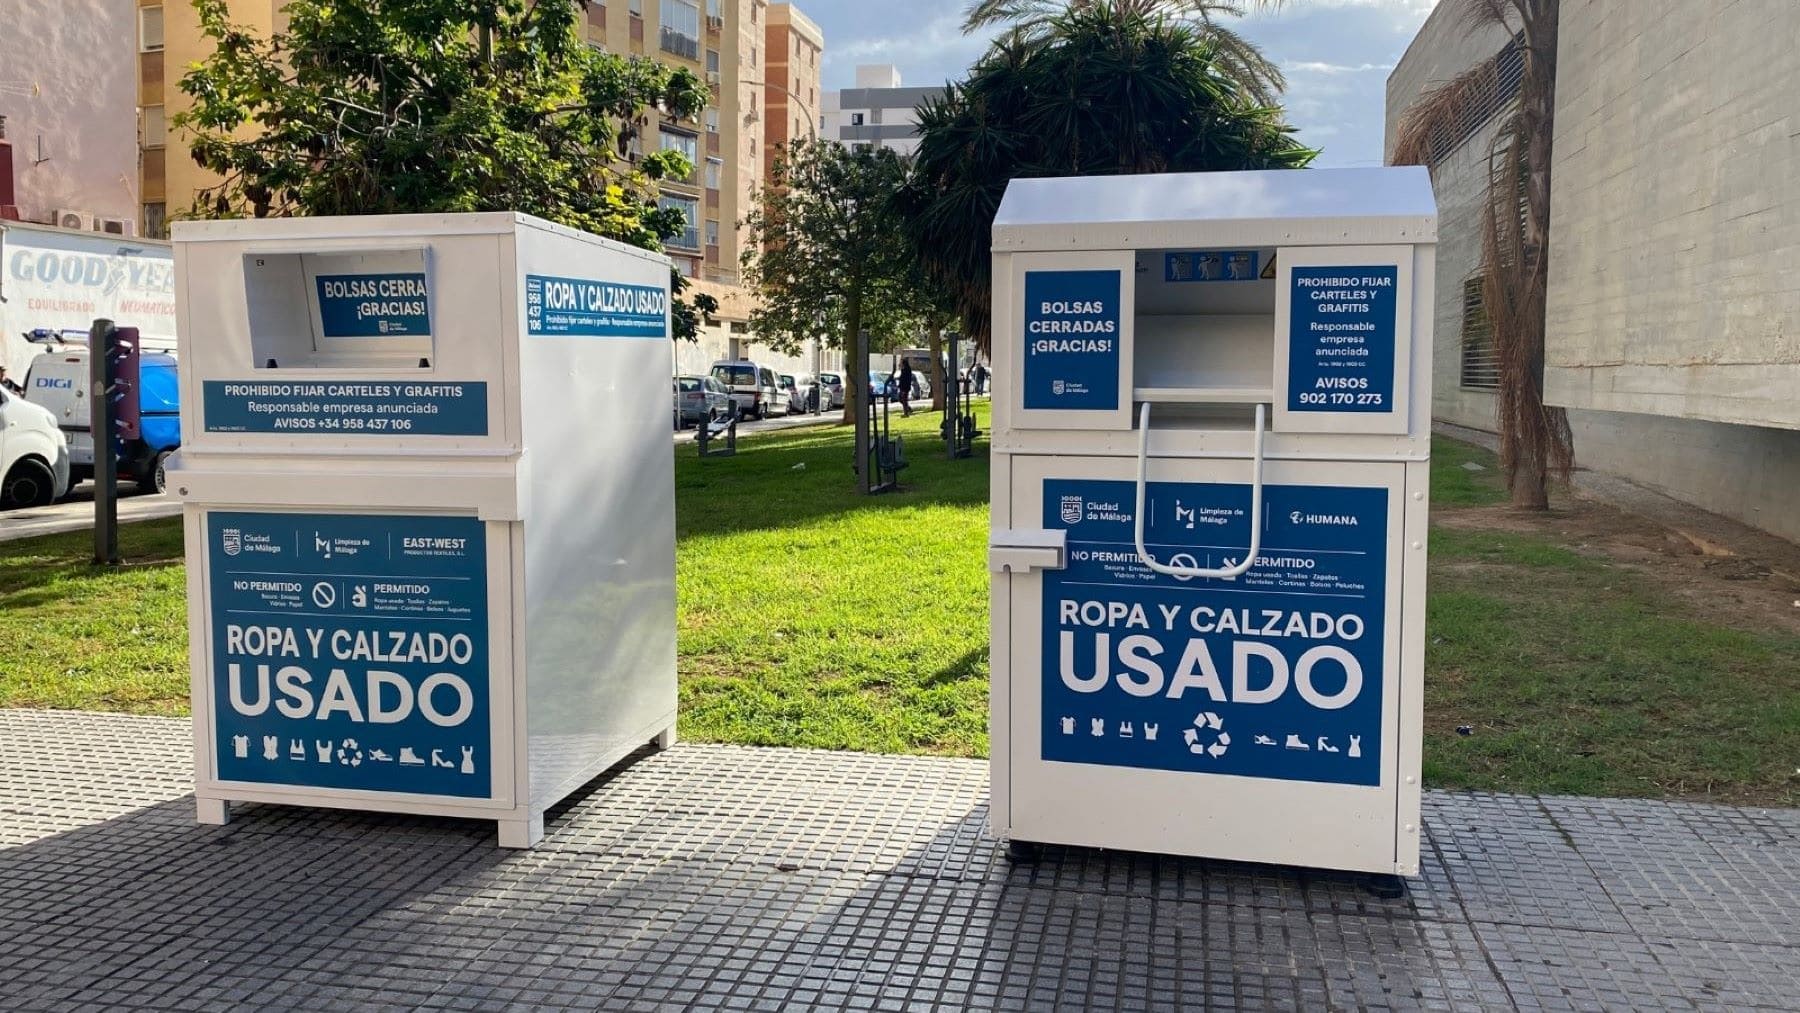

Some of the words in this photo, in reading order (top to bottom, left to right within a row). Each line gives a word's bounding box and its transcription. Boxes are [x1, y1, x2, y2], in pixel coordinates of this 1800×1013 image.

[324, 280, 378, 298] BOLSAS
[379, 279, 427, 297] CERRA
[1297, 278, 1360, 288] PROHIBIDO
[1361, 277, 1391, 287] FIJAR
[545, 281, 577, 310] ROPA
[577, 284, 586, 310] Y
[587, 285, 634, 314] CALZADO
[634, 289, 665, 315] USADO
[1310, 290, 1367, 300] CARTELES
[1369, 290, 1378, 299] Y
[357, 301, 425, 320] ¡GRACIAS!
[528, 305, 542, 318] 437
[1041, 301, 1103, 314] BOLSAS
[1318, 303, 1369, 313] GRAFITIS
[528, 319, 542, 331] 106
[1029, 321, 1115, 334] CERRADAS
[1310, 322, 1375, 333] Responsable
[1320, 336, 1365, 346] empresa
[1031, 340, 1112, 356] ¡GRACIAS!
[1315, 346, 1369, 357] anunciada
[36, 377, 72, 389] DIGI
[1315, 377, 1369, 389] AVISOS
[224, 385, 291, 397] PROHIBIDO
[293, 385, 326, 397] FIJAR
[328, 385, 391, 398] CARTELES
[393, 385, 402, 397] Y
[404, 386, 463, 398] GRAFITIS
[1299, 393, 1327, 404] 902
[1330, 393, 1354, 404] 170
[1357, 393, 1383, 405] 273
[247, 401, 320, 415] Responsable
[322, 403, 373, 416] empresa
[376, 402, 438, 414] anunciada
[273, 418, 316, 429] AVISOS
[318, 418, 340, 429] +34
[342, 418, 364, 430] 958
[366, 419, 388, 430] 437
[391, 419, 412, 430] 106
[1087, 502, 1119, 512] Ciudad
[1200, 507, 1233, 517] Limpieza
[1234, 508, 1244, 516] de
[1087, 512, 1099, 521] de
[1100, 512, 1132, 522] Málaga
[1200, 516, 1228, 526] Málaga
[1306, 513, 1358, 526] HUMANA
[244, 534, 270, 543] Ciudad
[244, 544, 254, 552] de
[1071, 551, 1089, 561] NO
[1253, 556, 1315, 569] ERMITIDO
[234, 581, 248, 591] NO
[250, 581, 302, 593] PERMITIDO
[373, 583, 430, 594] PERMITIDO
[1060, 599, 1149, 629] ROPA
[1158, 604, 1181, 630] Y
[1190, 606, 1364, 640] CALZADO
[227, 625, 300, 657] ROPA
[306, 628, 324, 659] Y
[331, 629, 473, 665] CALZADO
[1060, 630, 1363, 710] USADO
[228, 663, 474, 728] USADO
